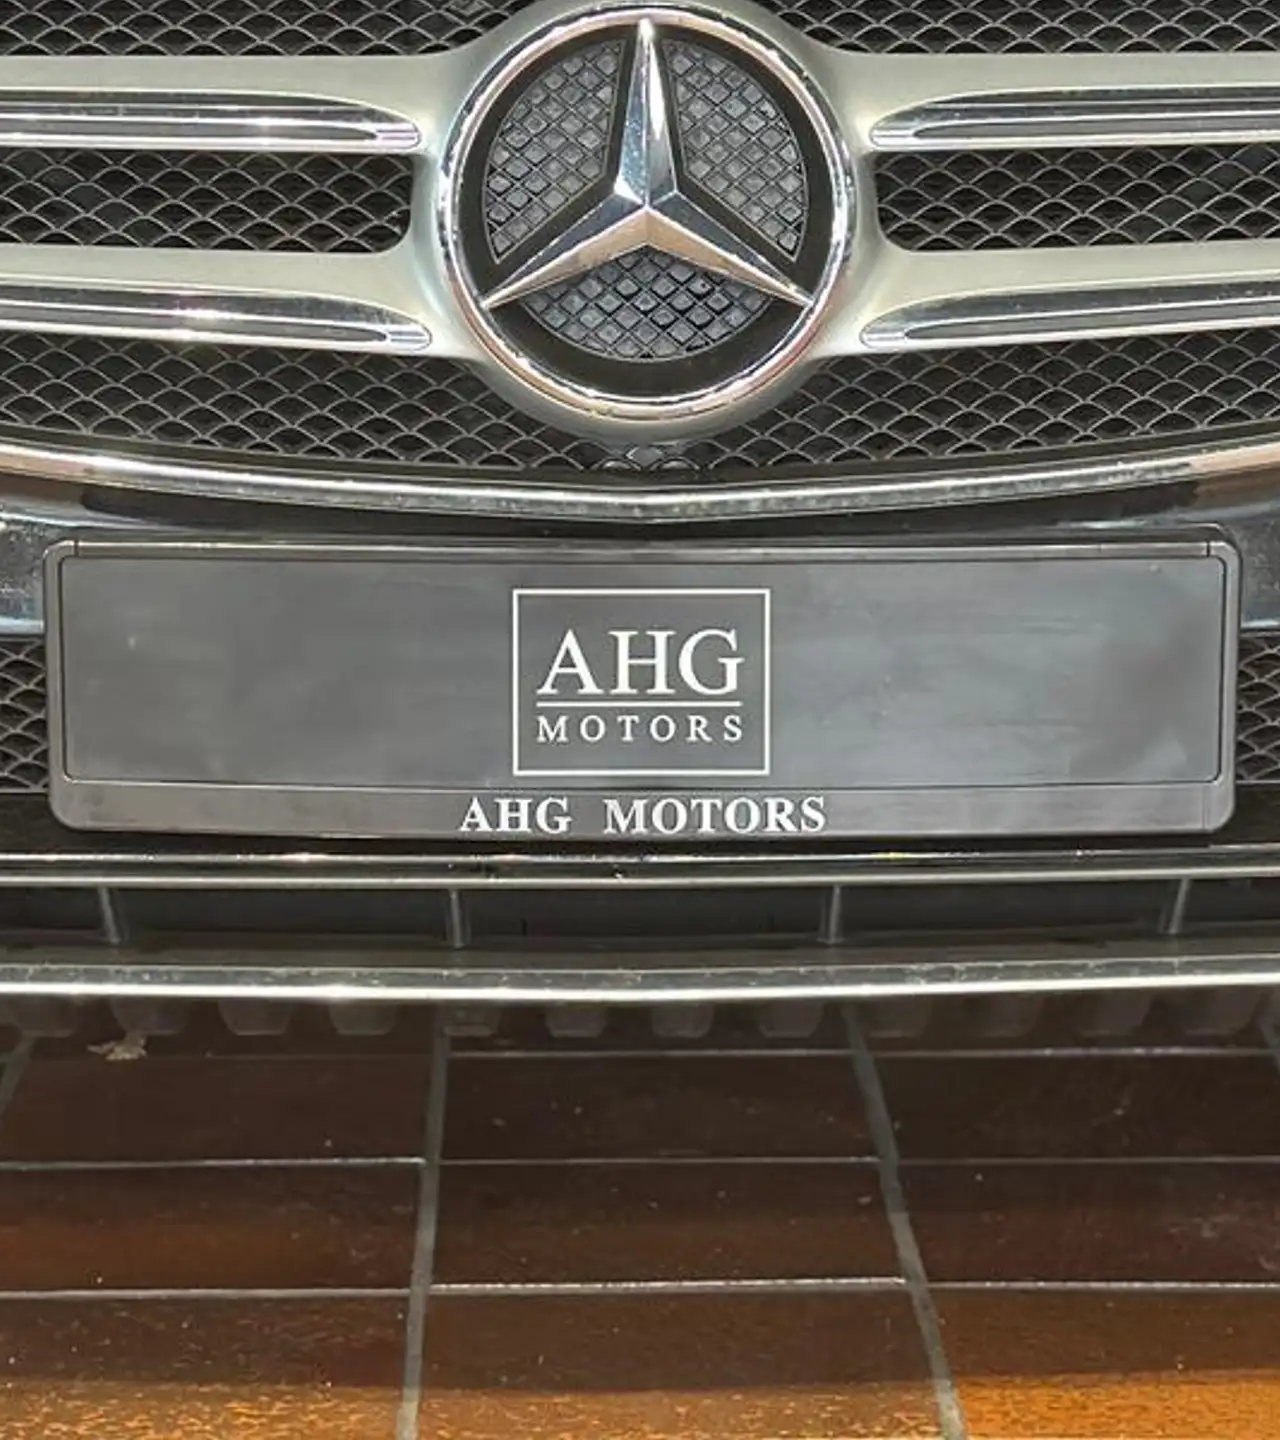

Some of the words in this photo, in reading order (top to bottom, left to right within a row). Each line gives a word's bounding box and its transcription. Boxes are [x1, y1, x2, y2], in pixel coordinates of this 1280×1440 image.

[536, 629, 745, 696] AHG
[537, 713, 743, 744] MOTORS
[459, 796, 572, 835] AHG
[603, 795, 827, 836] MOTORS
